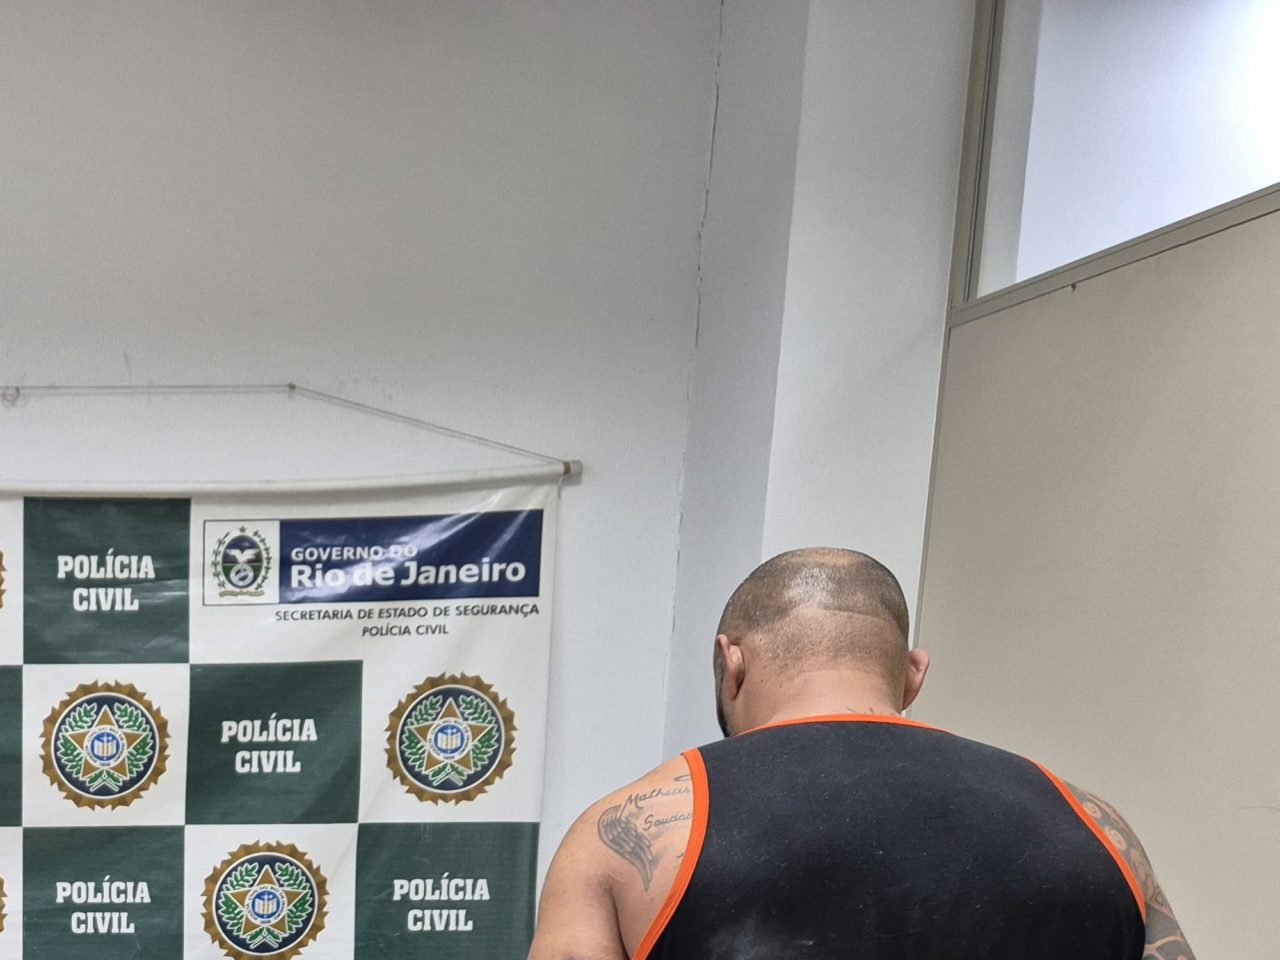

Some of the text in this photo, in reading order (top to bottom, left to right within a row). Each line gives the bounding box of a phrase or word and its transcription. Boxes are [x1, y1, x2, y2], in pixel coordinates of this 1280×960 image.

[58, 548, 155, 579] POLÍCIA
[291, 544, 418, 561] GOVERNO DO
[291, 557, 526, 589] Rio de Janeiro
[73, 588, 139, 611] CIVIL
[275, 603, 540, 621] SECRETARIA DE ESTADO DE SEGURANÇA
[362, 623, 449, 637] POLÍCIA CIVIL
[221, 713, 317, 742] POLÍCIA
[236, 751, 301, 773] CIVIL
[56, 875, 150, 903] POLÍCIA
[393, 872, 490, 900] POLÍCIA
[72, 912, 134, 933] CIVIL
[408, 909, 473, 931] CIVIL
